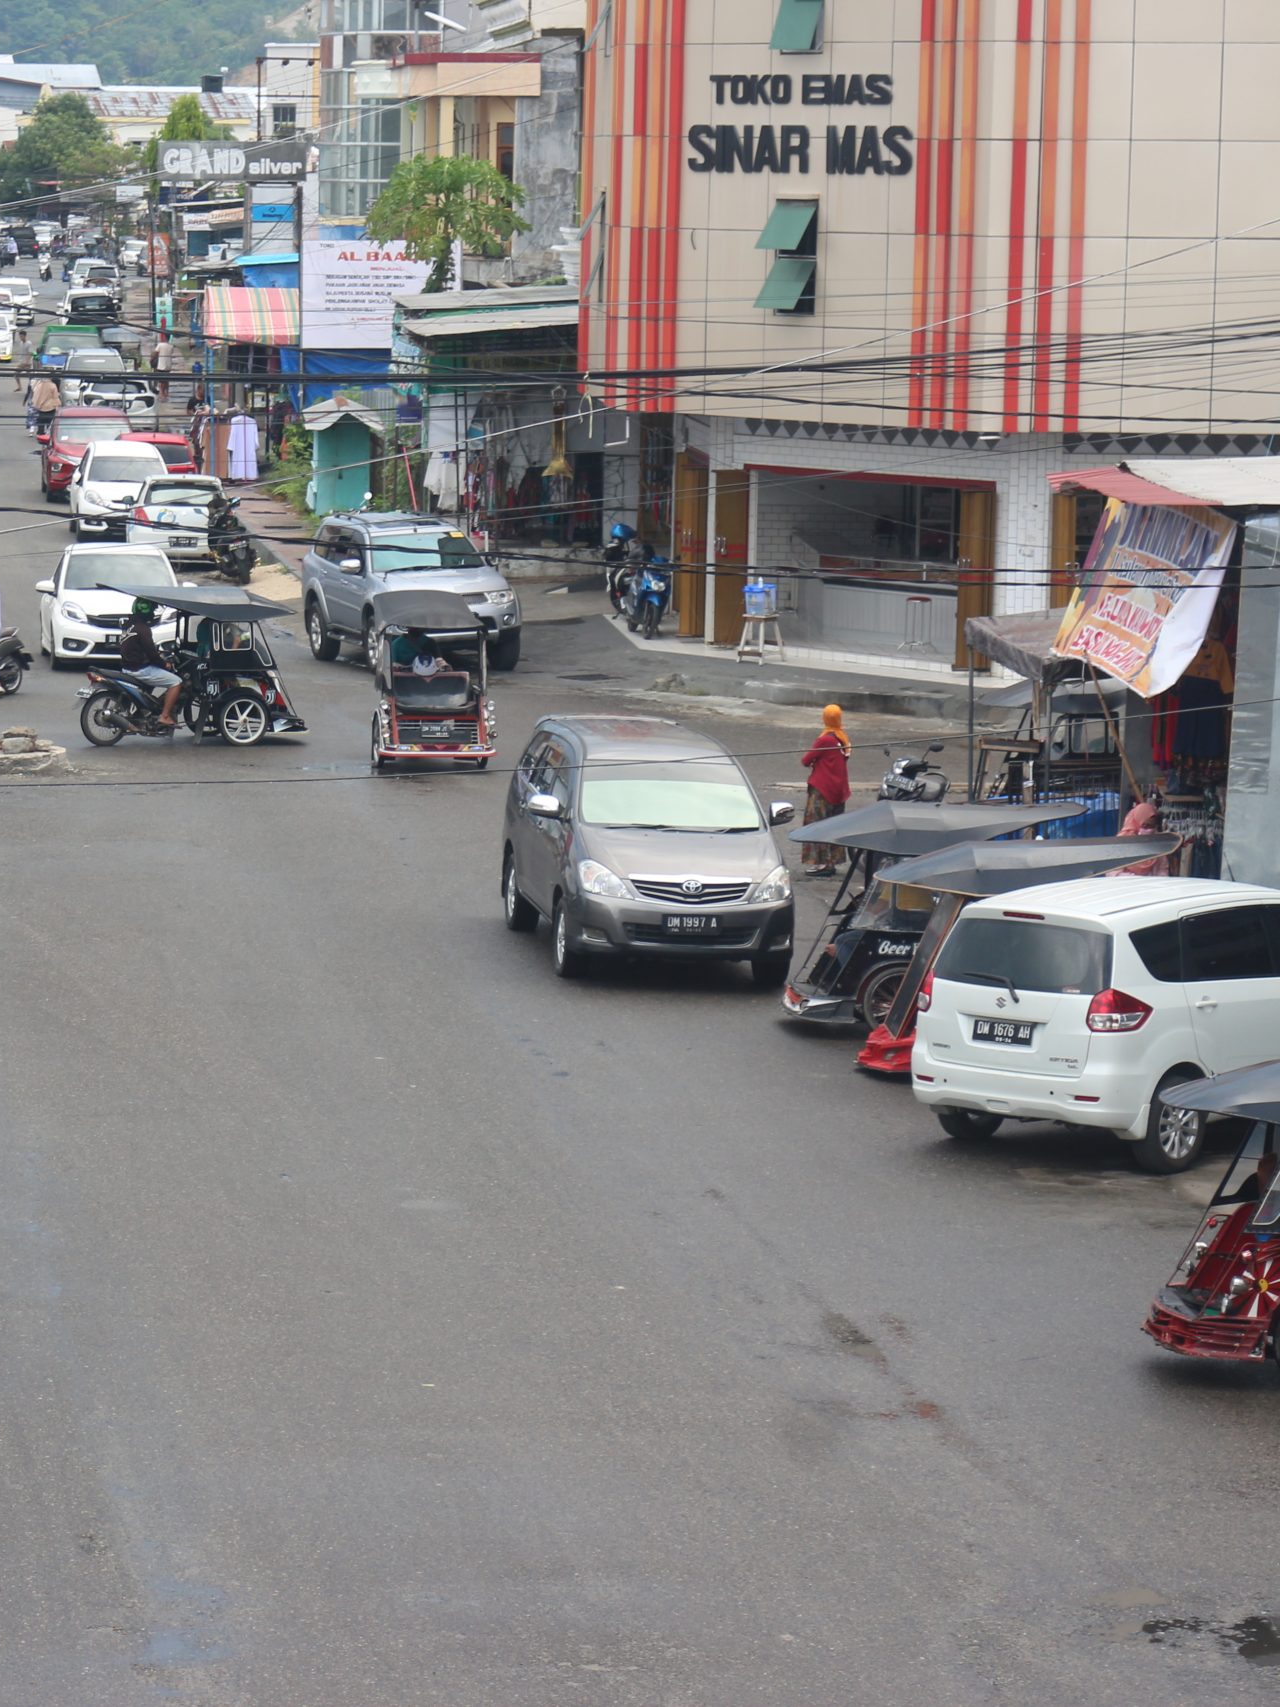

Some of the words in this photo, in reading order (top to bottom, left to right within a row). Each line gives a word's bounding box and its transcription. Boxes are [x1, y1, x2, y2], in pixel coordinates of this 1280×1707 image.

[709, 74, 792, 105] TOKO
[801, 74, 894, 105] EMAS
[687, 124, 810, 174] SINAR
[826, 125, 914, 176] MAS
[163, 148, 246, 175] GRAND
[248, 158, 303, 175] silver
[337, 251, 363, 262] AL
[667, 916, 680, 928] DM
[682, 916, 706, 928] 1997
[711, 917, 718, 928] A
[878, 940, 912, 955] Beer
[977, 1021, 990, 1035] DM
[994, 1023, 1015, 1038] 1676
[1018, 1025, 1031, 1040] AH
